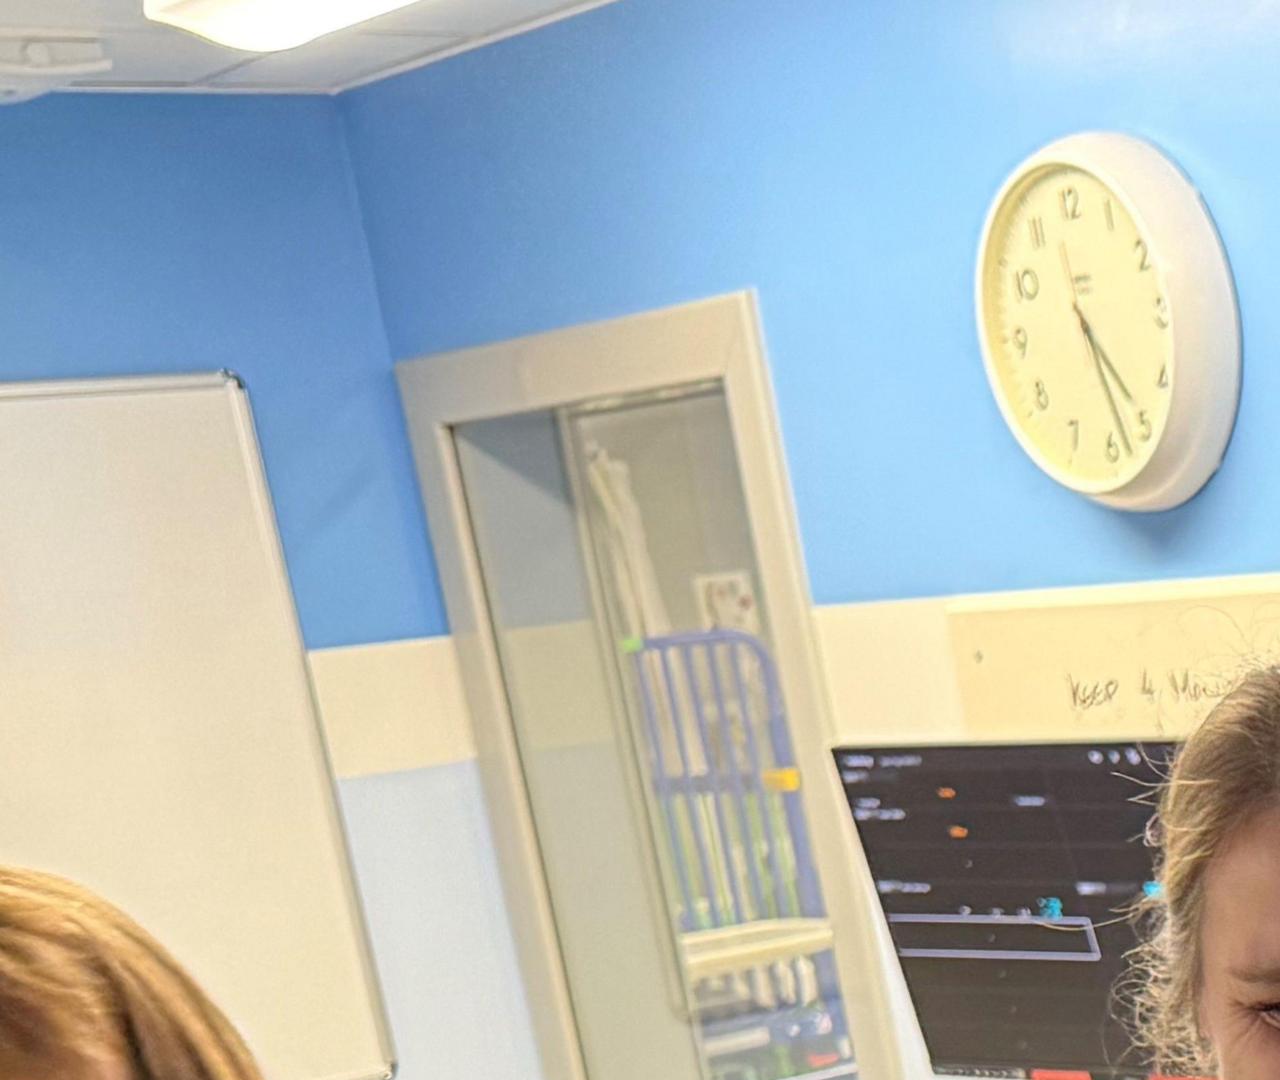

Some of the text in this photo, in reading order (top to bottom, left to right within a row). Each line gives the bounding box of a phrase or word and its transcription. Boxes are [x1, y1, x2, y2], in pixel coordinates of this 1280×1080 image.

[1058, 187, 1083, 220] 12
[1104, 199, 1115, 231] 1
[1029, 216, 1047, 249] 11
[1133, 238, 1151, 271] 2
[1015, 269, 1040, 301] 10
[1012, 327, 1029, 360] 9
[1155, 364, 1170, 389] 4
[1033, 381, 1049, 411] 8
[1067, 419, 1080, 452] 7
[1137, 410, 1153, 442] 5
[1103, 433, 1120, 465] 6
